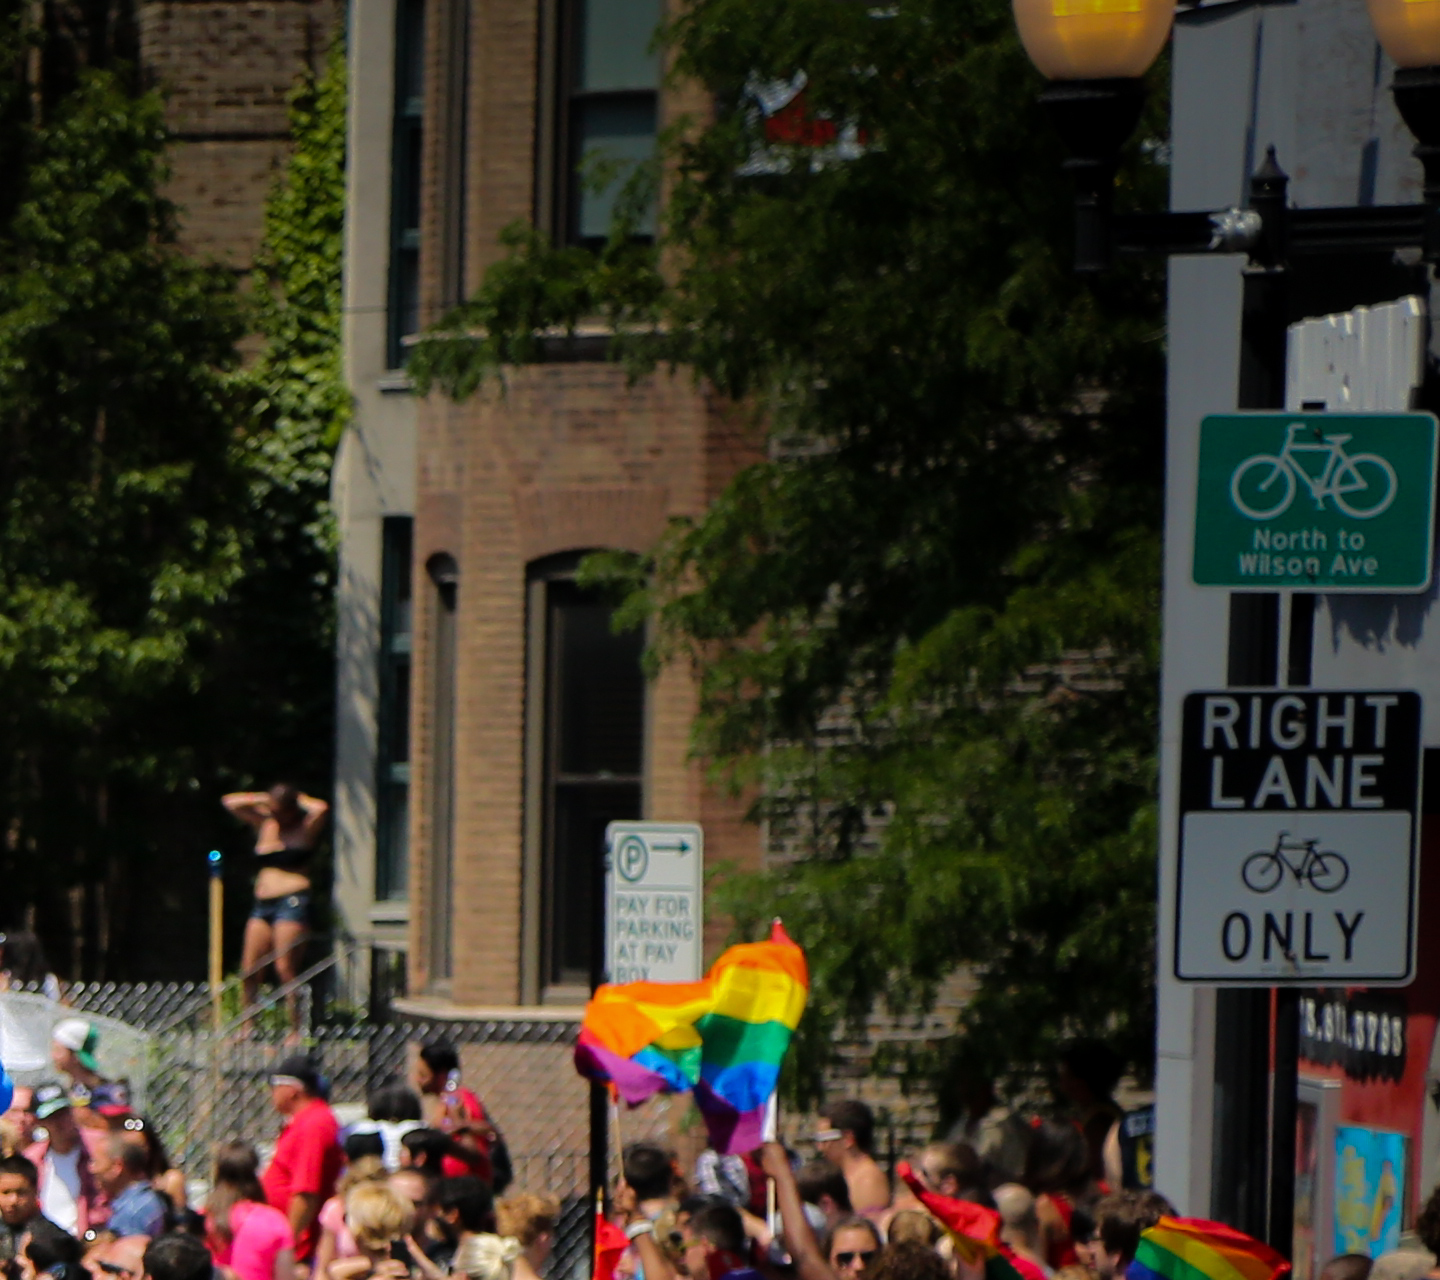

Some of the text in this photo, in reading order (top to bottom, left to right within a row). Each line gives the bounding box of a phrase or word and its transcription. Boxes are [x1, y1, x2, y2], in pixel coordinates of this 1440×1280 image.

[1254, 529, 1365, 550] North to
[1240, 553, 1378, 576] Wilson Ave
[1203, 696, 1399, 750] RIGHT
[1211, 755, 1385, 809] LANE
[617, 893, 690, 915] PAY FOR
[617, 919, 694, 940] PARKING
[1222, 911, 1365, 962] ONLY
[619, 942, 678, 962] AT PAY
